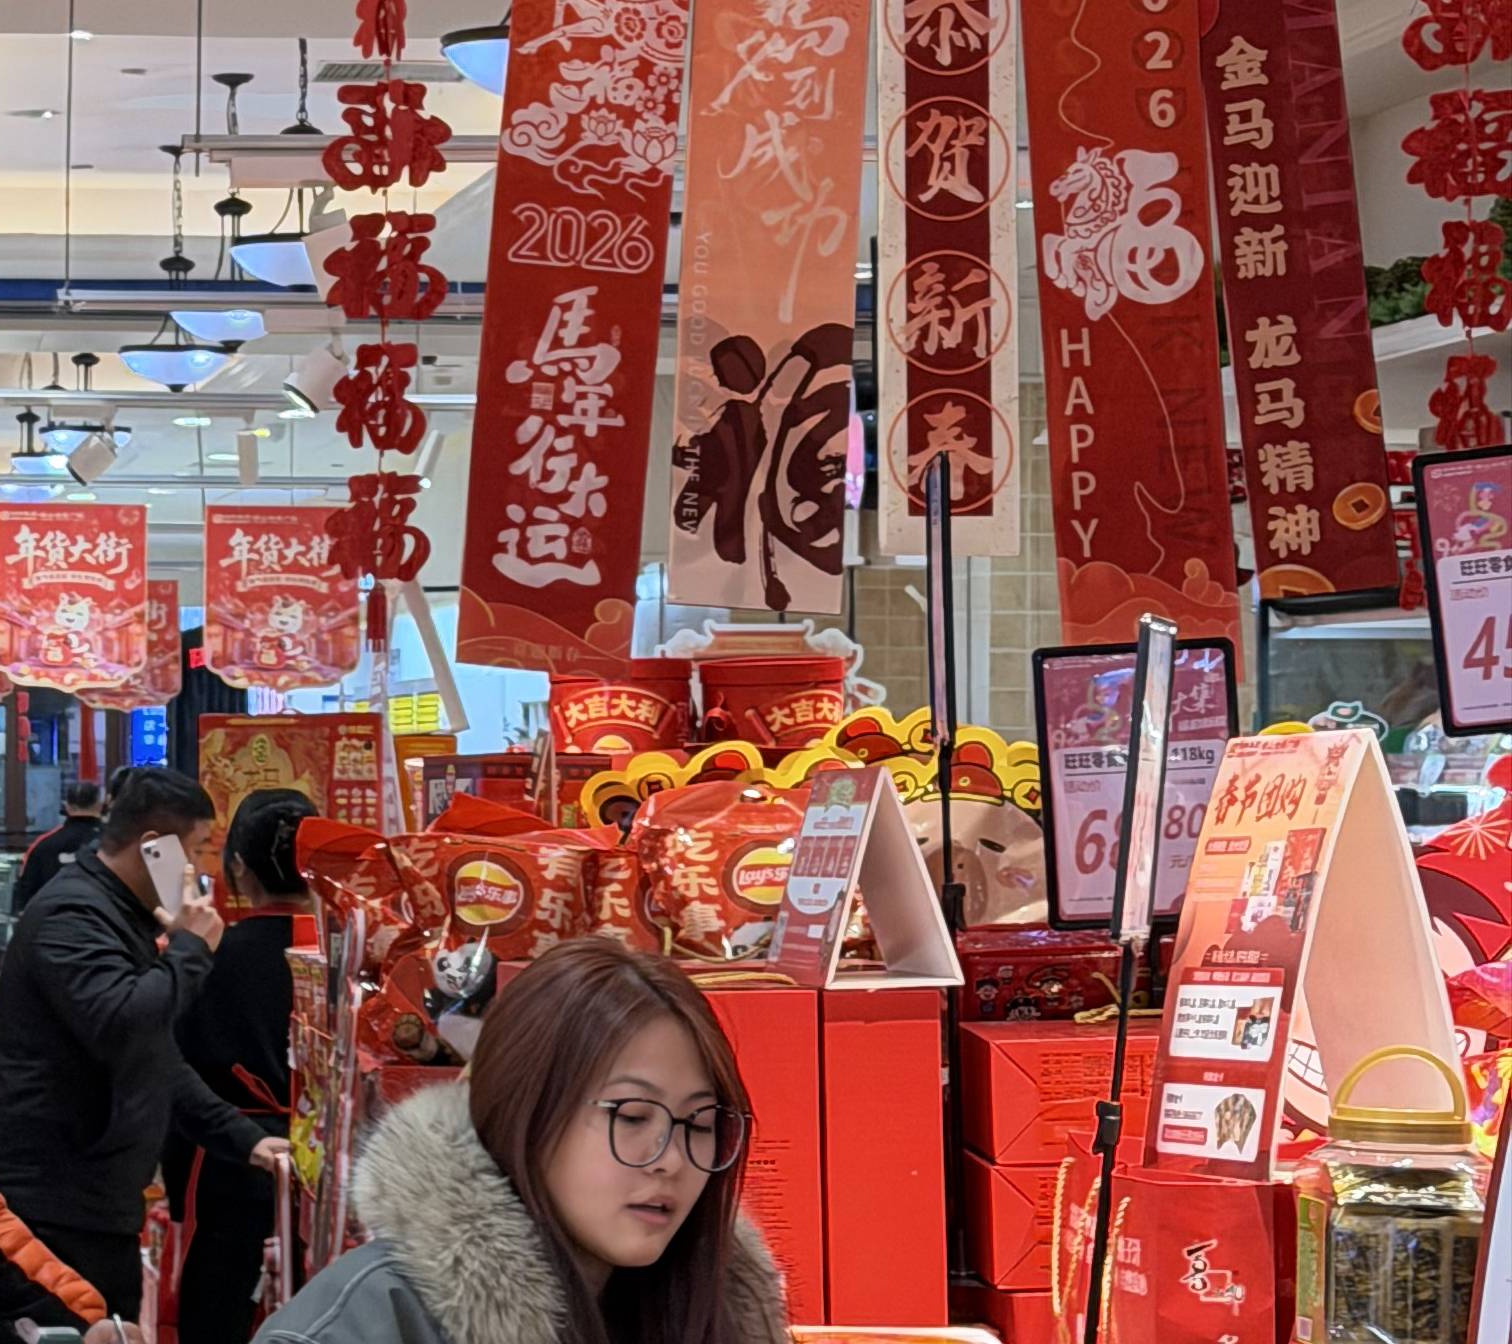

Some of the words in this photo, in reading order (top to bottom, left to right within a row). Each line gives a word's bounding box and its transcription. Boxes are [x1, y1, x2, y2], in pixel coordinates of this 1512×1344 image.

[1217, 34, 1290, 282] 金马迎新
[507, 202, 654, 274] 2026
[1060, 326, 1098, 560] HAPPY
[1244, 312, 1322, 560] 龙马精神
[5, 523, 134, 577] 年货大街
[564, 693, 661, 727] 大吉大利
